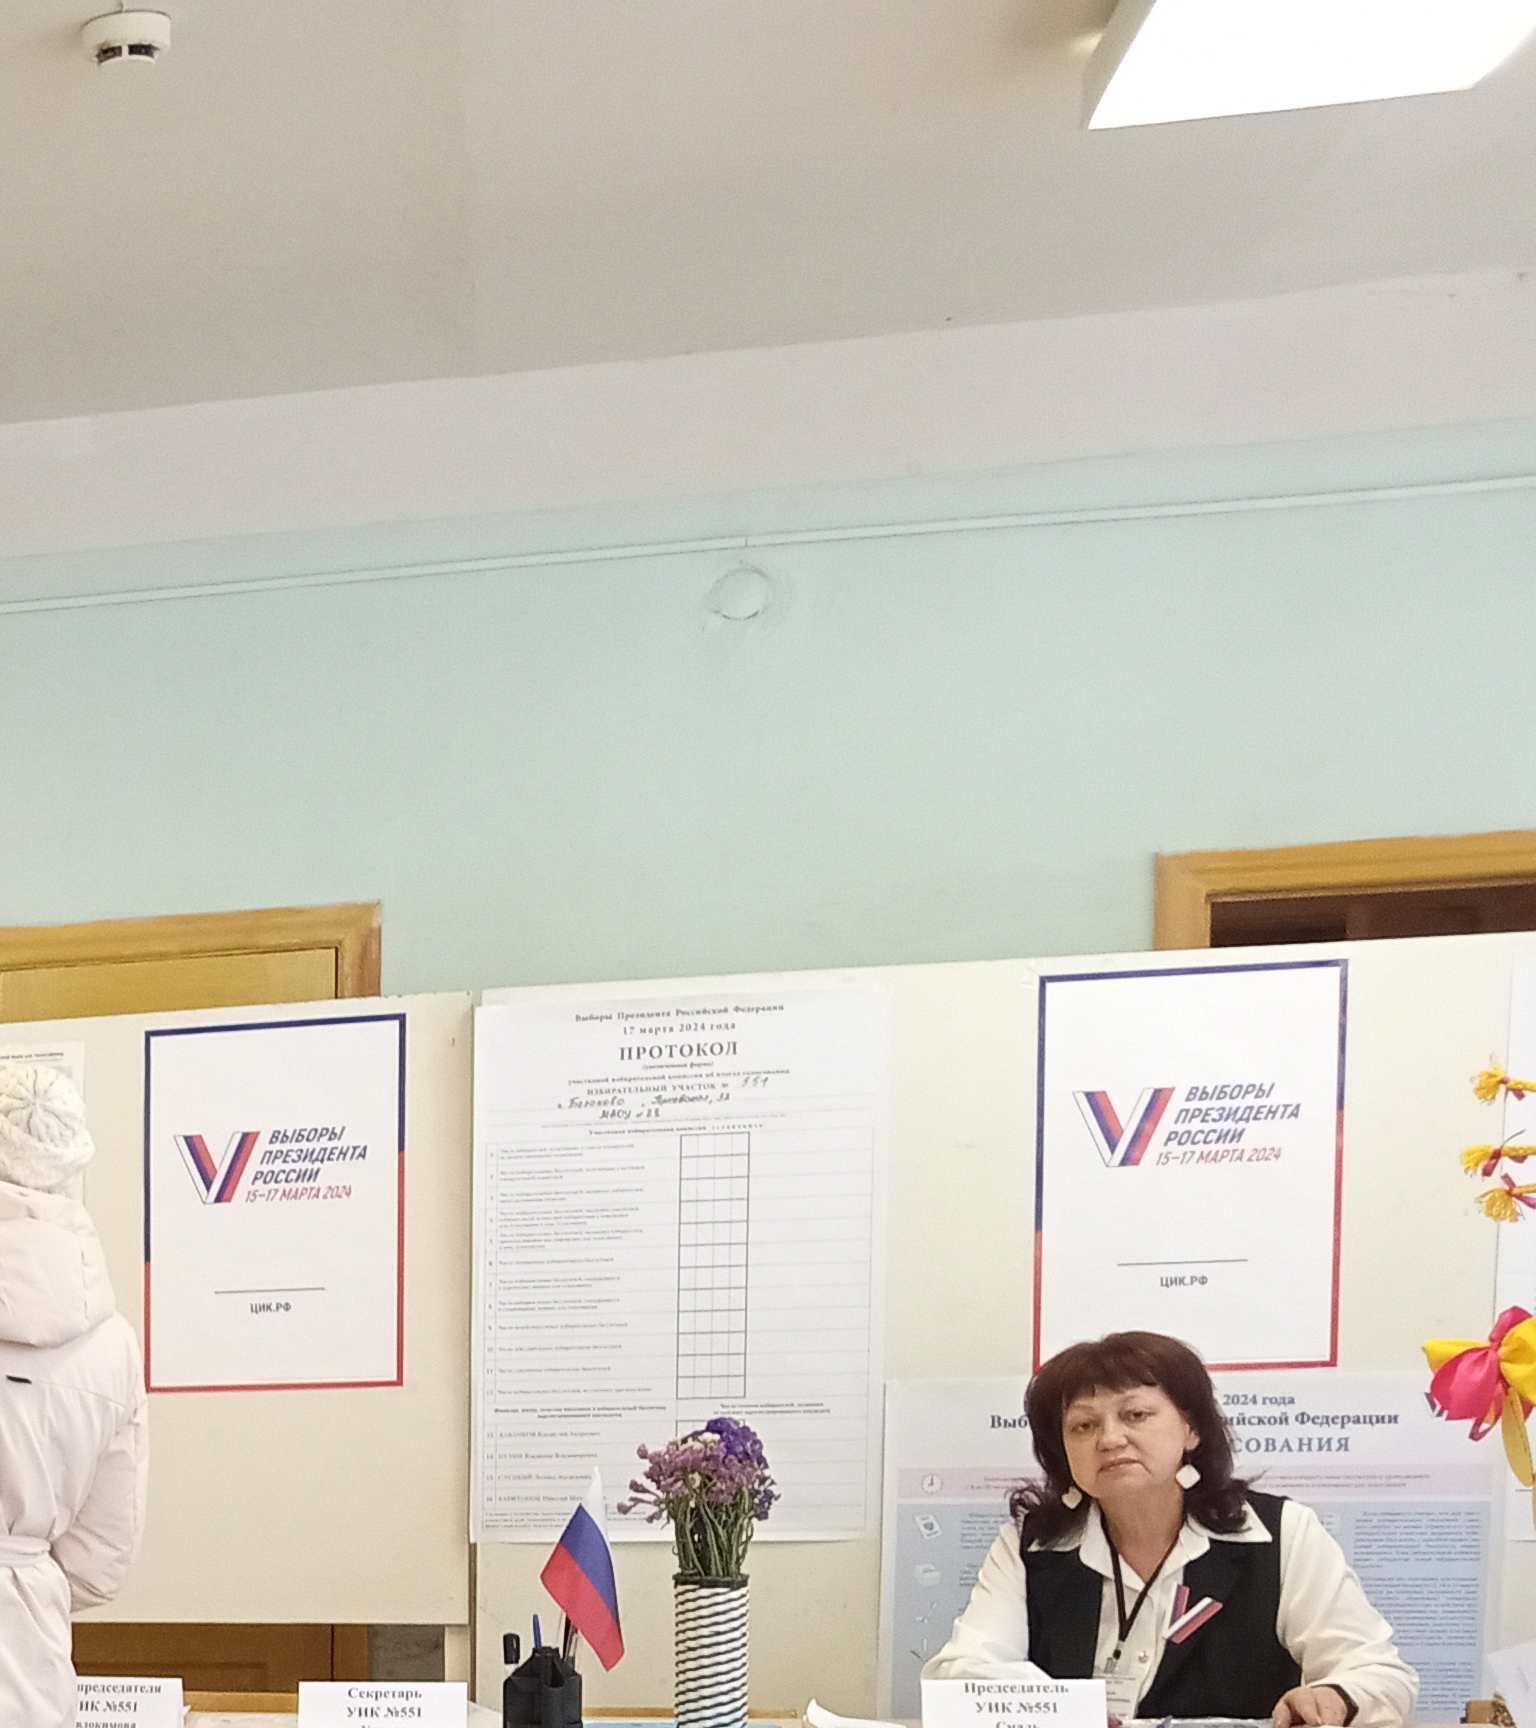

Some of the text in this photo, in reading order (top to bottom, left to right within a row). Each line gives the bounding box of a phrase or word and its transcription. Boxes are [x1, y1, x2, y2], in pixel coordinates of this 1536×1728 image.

[640, 1026, 674, 1036] марта
[679, 1022, 705, 1032] 2024
[710, 1022, 736, 1031] года
[619, 1041, 737, 1061] ПРОТОКОЛ
[1185, 1082, 1276, 1102] ВЫБОРЫ
[1174, 1103, 1301, 1125] ПРЕЗИДЕНТА
[268, 1126, 346, 1144] ВЫБОРЫ
[1163, 1128, 1246, 1147] РОССИИ
[260, 1145, 368, 1165] ПРЕЗИДЕНТА
[1196, 1149, 1245, 1164] МАРТА
[1247, 1147, 1282, 1162] 2024
[251, 1167, 321, 1185] РОССИИ
[279, 1187, 321, 1201] МАРТА
[323, 1185, 352, 1200] 2024
[1160, 1275, 1208, 1288] ЦИК.РФ
[250, 1302, 291, 1314] ЦИК.РФ
[1222, 1394, 1296, 1406] 2024 года
[990, 1411, 1399, 1429] Выб ийской Федерации
[1231, 1437, 1350, 1453] СОВАНИЯ
[348, 1687, 423, 1702] Секретарь
[964, 1682, 1069, 1696] Председатель
[79, 1700, 138, 1712] ИК №551
[346, 1706, 422, 1718] УИК №551
[975, 1701, 1058, 1713] УИК №551
